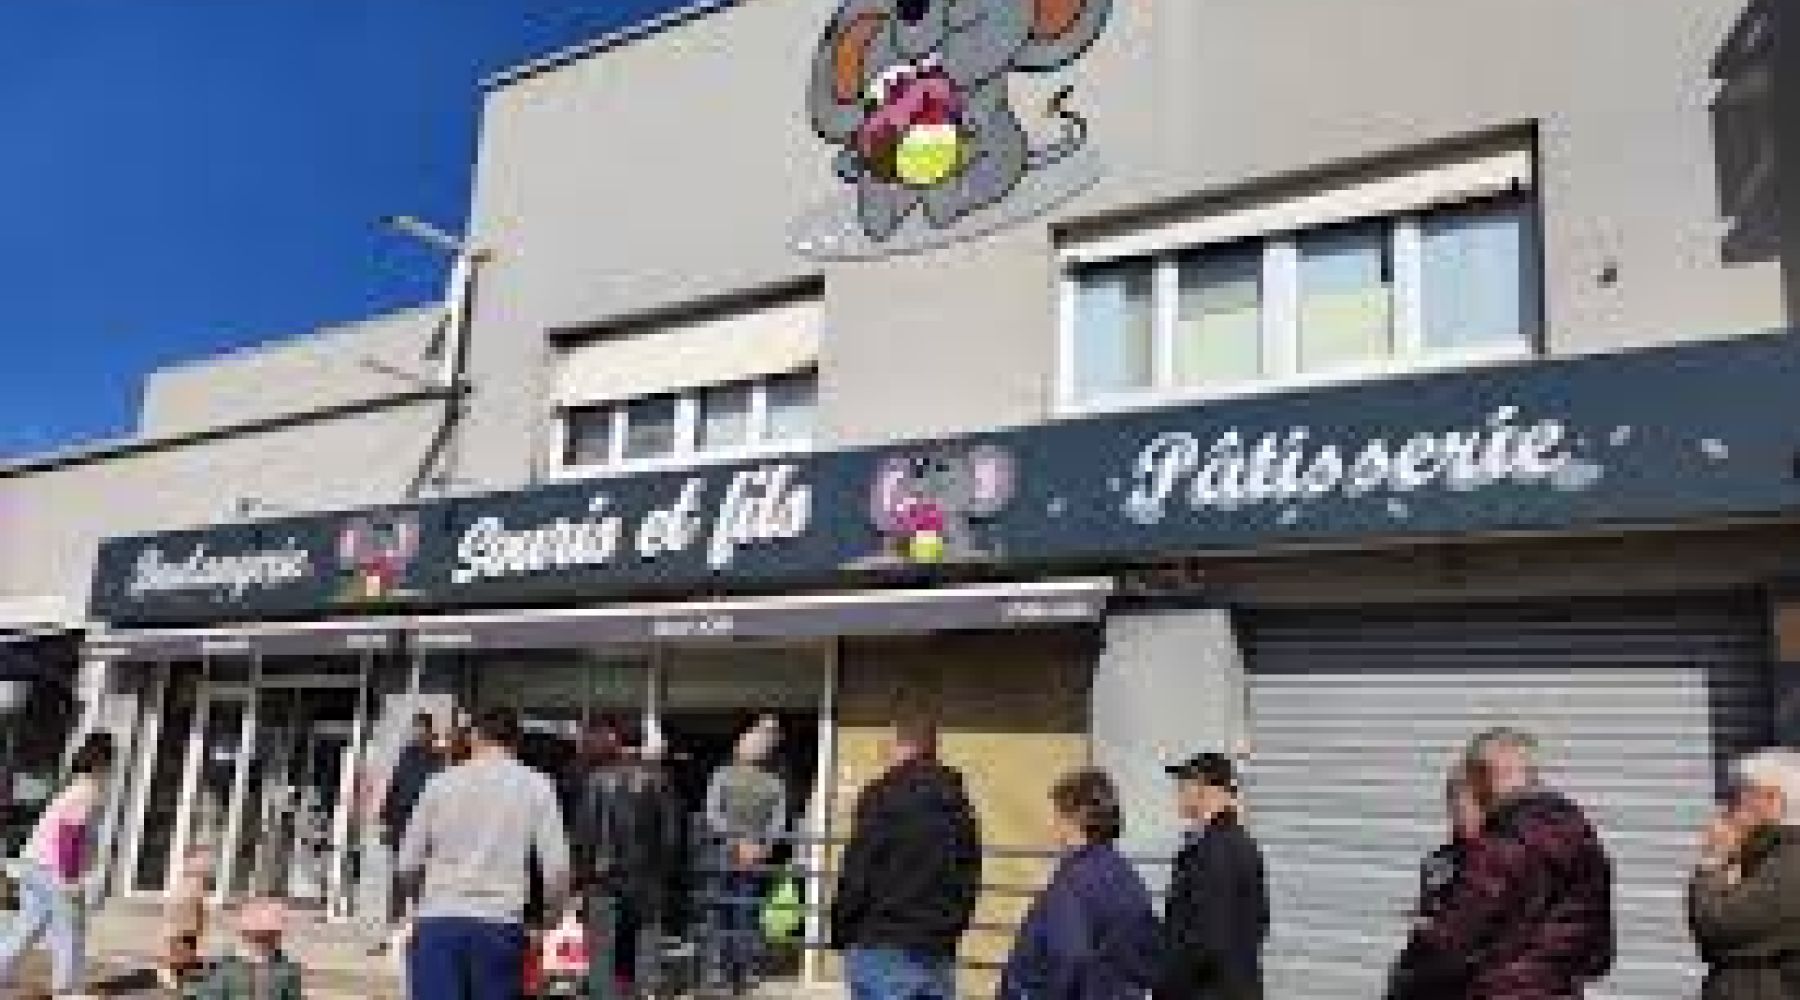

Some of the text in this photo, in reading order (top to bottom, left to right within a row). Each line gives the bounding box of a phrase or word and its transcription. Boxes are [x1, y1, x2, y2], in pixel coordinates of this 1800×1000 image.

[451, 464, 813, 584] Souris et fils
[1123, 405, 1567, 524] Pâtisserie
